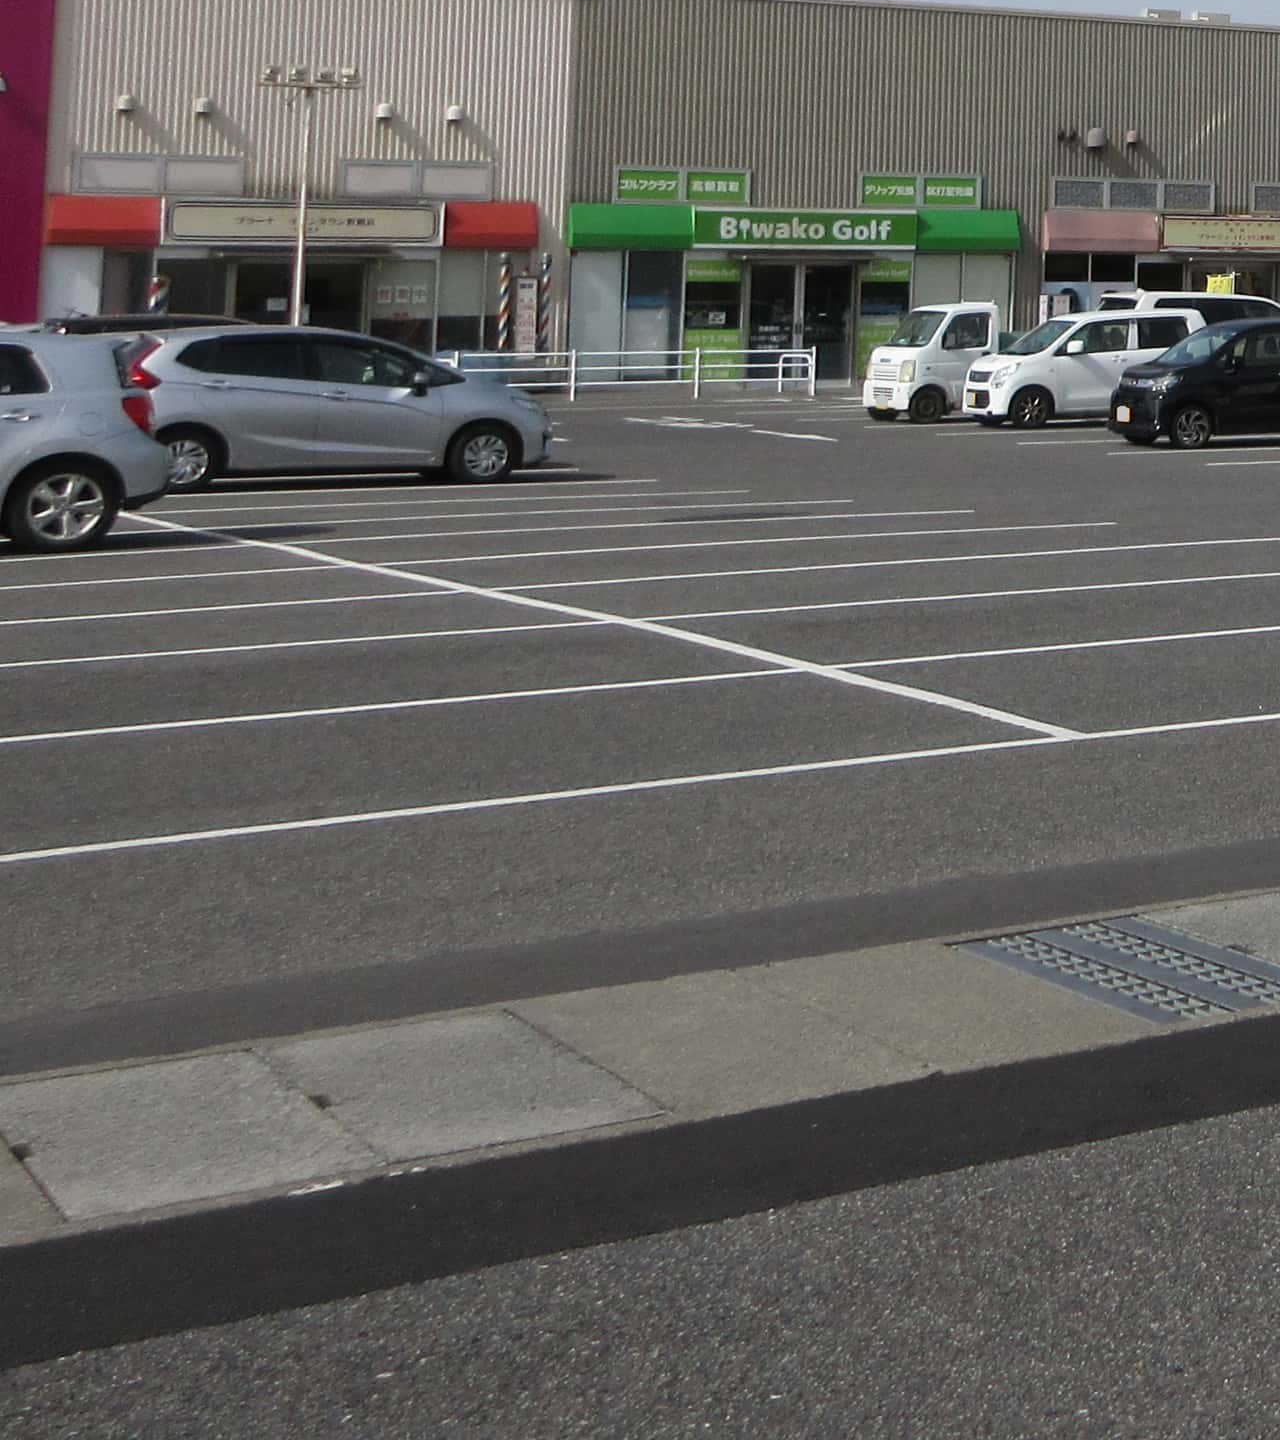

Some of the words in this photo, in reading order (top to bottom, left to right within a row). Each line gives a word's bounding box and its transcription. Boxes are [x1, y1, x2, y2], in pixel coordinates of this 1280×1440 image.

[619, 178, 677, 192] ゴルフクラブ
[720, 216, 825, 241] Biwako
[832, 217, 892, 242] Golf
